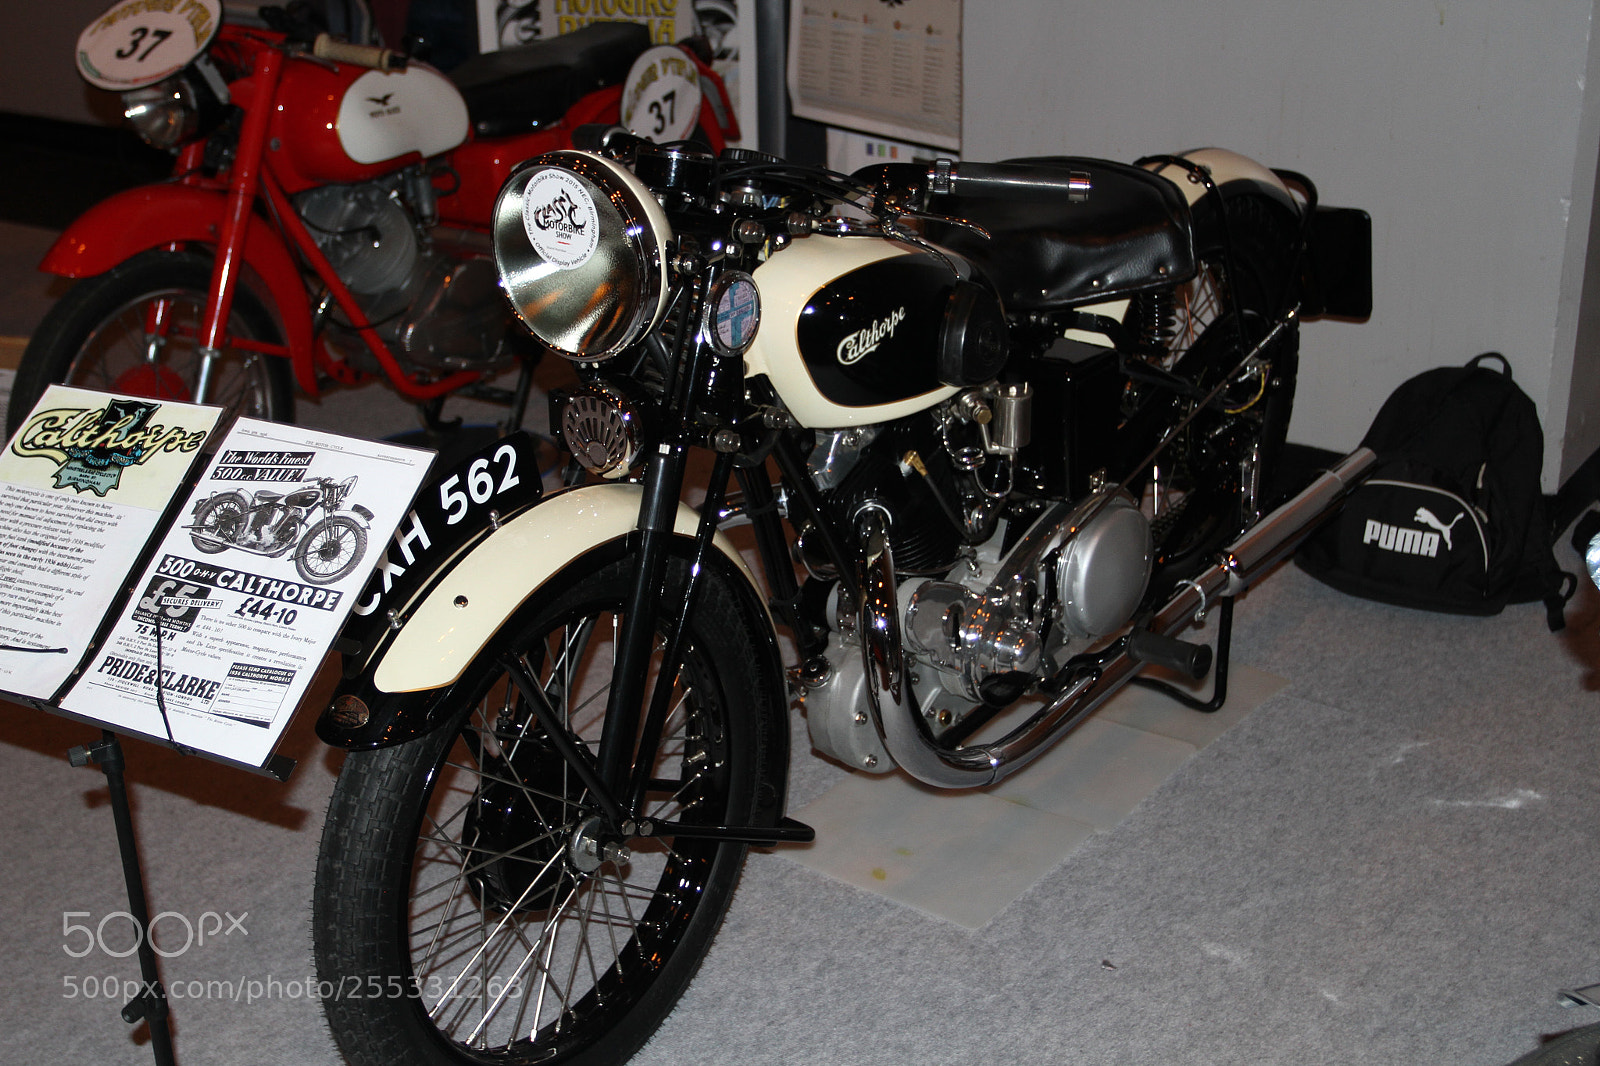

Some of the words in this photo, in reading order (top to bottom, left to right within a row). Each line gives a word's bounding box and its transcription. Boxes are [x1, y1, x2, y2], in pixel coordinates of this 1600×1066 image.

[116, 27, 173, 62] 37
[648, 89, 676, 135] 37
[549, 173, 564, 181] Show
[565, 178, 578, 189] 2015
[544, 219, 585, 236] MOTORBIKE
[555, 230, 572, 240] SHOW
[837, 306, 906, 365] Calthorpe
[11, 408, 206, 467] Calthorpe
[221, 450, 243, 464] The
[243, 452, 280, 464] World's
[279, 453, 313, 465] Finest
[213, 467, 243, 480] 500
[254, 468, 306, 481] VALUE!
[440, 444, 520, 525] 562
[1363, 519, 1440, 558] PUMA
[161, 557, 193, 579] 500
[216, 570, 340, 610] CALTHORPE
[140, 580, 200, 618] £5
[162, 597, 189, 606] SECURES
[190, 599, 220, 607] DELIVERY
[135, 624, 149, 634] 75
[241, 671, 269, 680] CALTHORPE
[269, 675, 292, 683] MODELS
